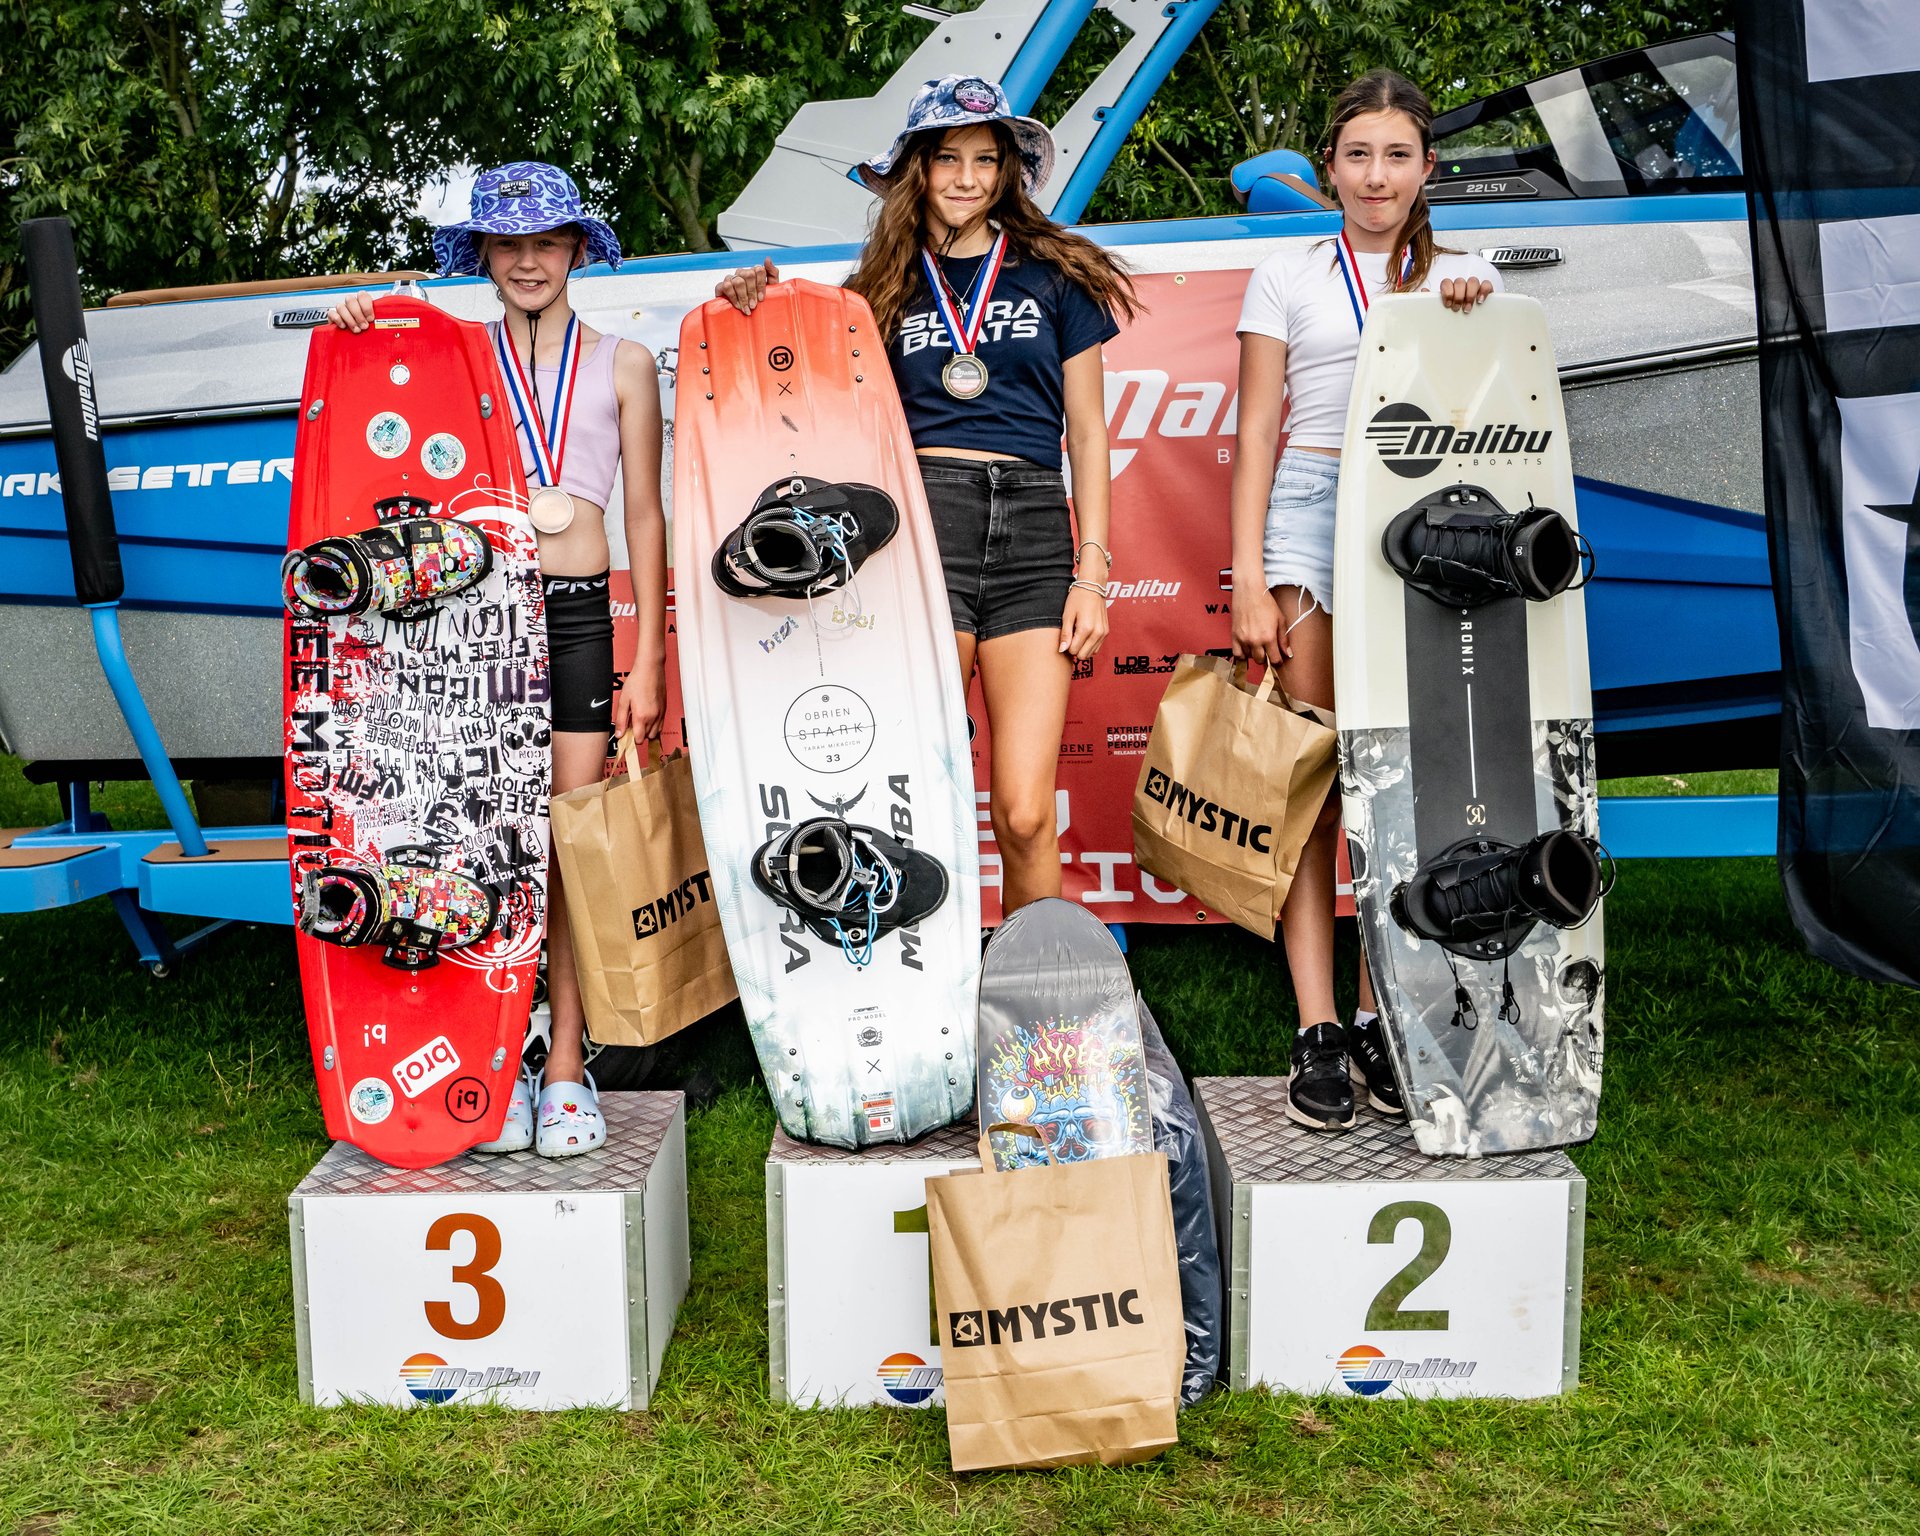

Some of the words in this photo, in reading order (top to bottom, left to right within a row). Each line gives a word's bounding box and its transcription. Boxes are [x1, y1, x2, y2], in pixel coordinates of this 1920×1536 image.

[1466, 183, 1507, 193] 22LSV
[900, 299, 1042, 336] SURA
[1473, 458, 1542, 466] BOATS
[468, 637, 530, 663] FREE
[1460, 622, 1474, 675] RONIX
[1114, 656, 1150, 668] LDB
[1114, 664, 1176, 675] WAKESCHOO
[396, 671, 481, 702] ICON
[428, 698, 513, 720] MOTION
[804, 708, 850, 721] OBRIEN
[364, 724, 417, 753] FREE
[798, 722, 863, 741] SPARK
[1107, 726, 1154, 734] EXTREME
[1107, 733, 1148, 742] SPORTS
[519, 750, 544, 758] ICON
[1107, 740, 1150, 748] PERFOR
[826, 754, 841, 763] 33
[335, 767, 379, 800] FM
[1167, 781, 1272, 854] MYSTIC
[480, 869, 516, 885] MOTIO
[656, 870, 711, 931] MYST
[364, 1024, 386, 1047] b!
[397, 1042, 456, 1093] bro!
[457, 1090, 478, 1110] b!
[424, 1212, 506, 1340] 3
[1364, 1200, 1452, 1332] 2
[987, 1289, 1144, 1345] MYSTIC
